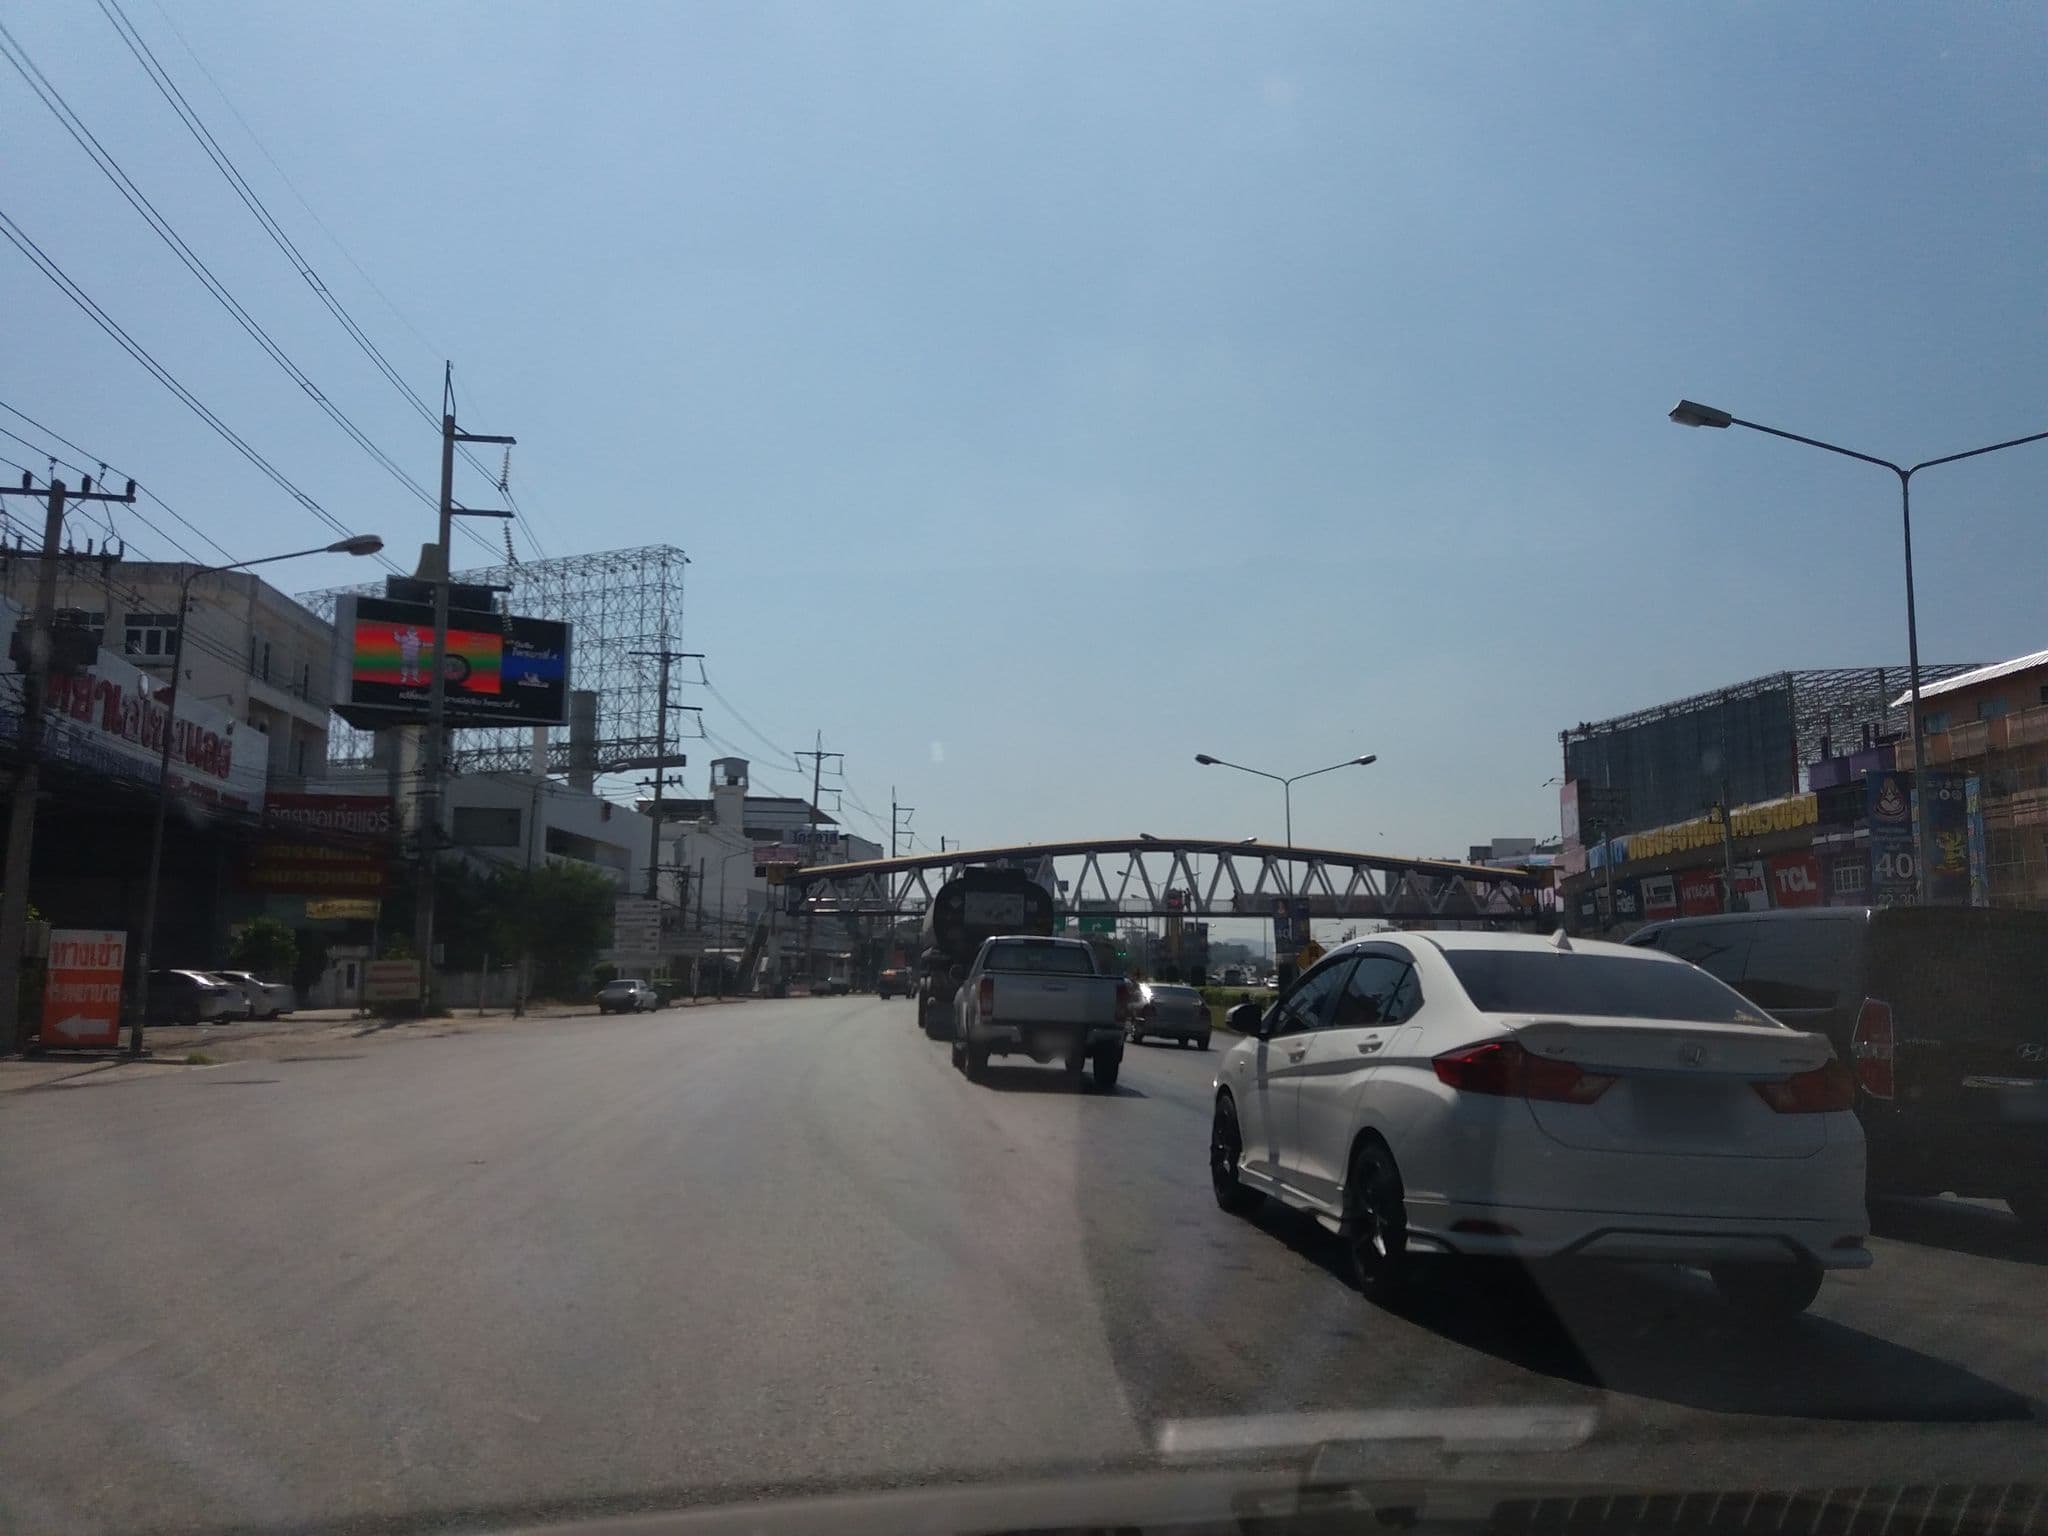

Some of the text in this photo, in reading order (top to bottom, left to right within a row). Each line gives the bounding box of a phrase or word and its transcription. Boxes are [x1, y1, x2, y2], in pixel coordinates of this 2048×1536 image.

[1775, 866, 1817, 892] TCL
[52, 933, 122, 966] ทางเข้า
